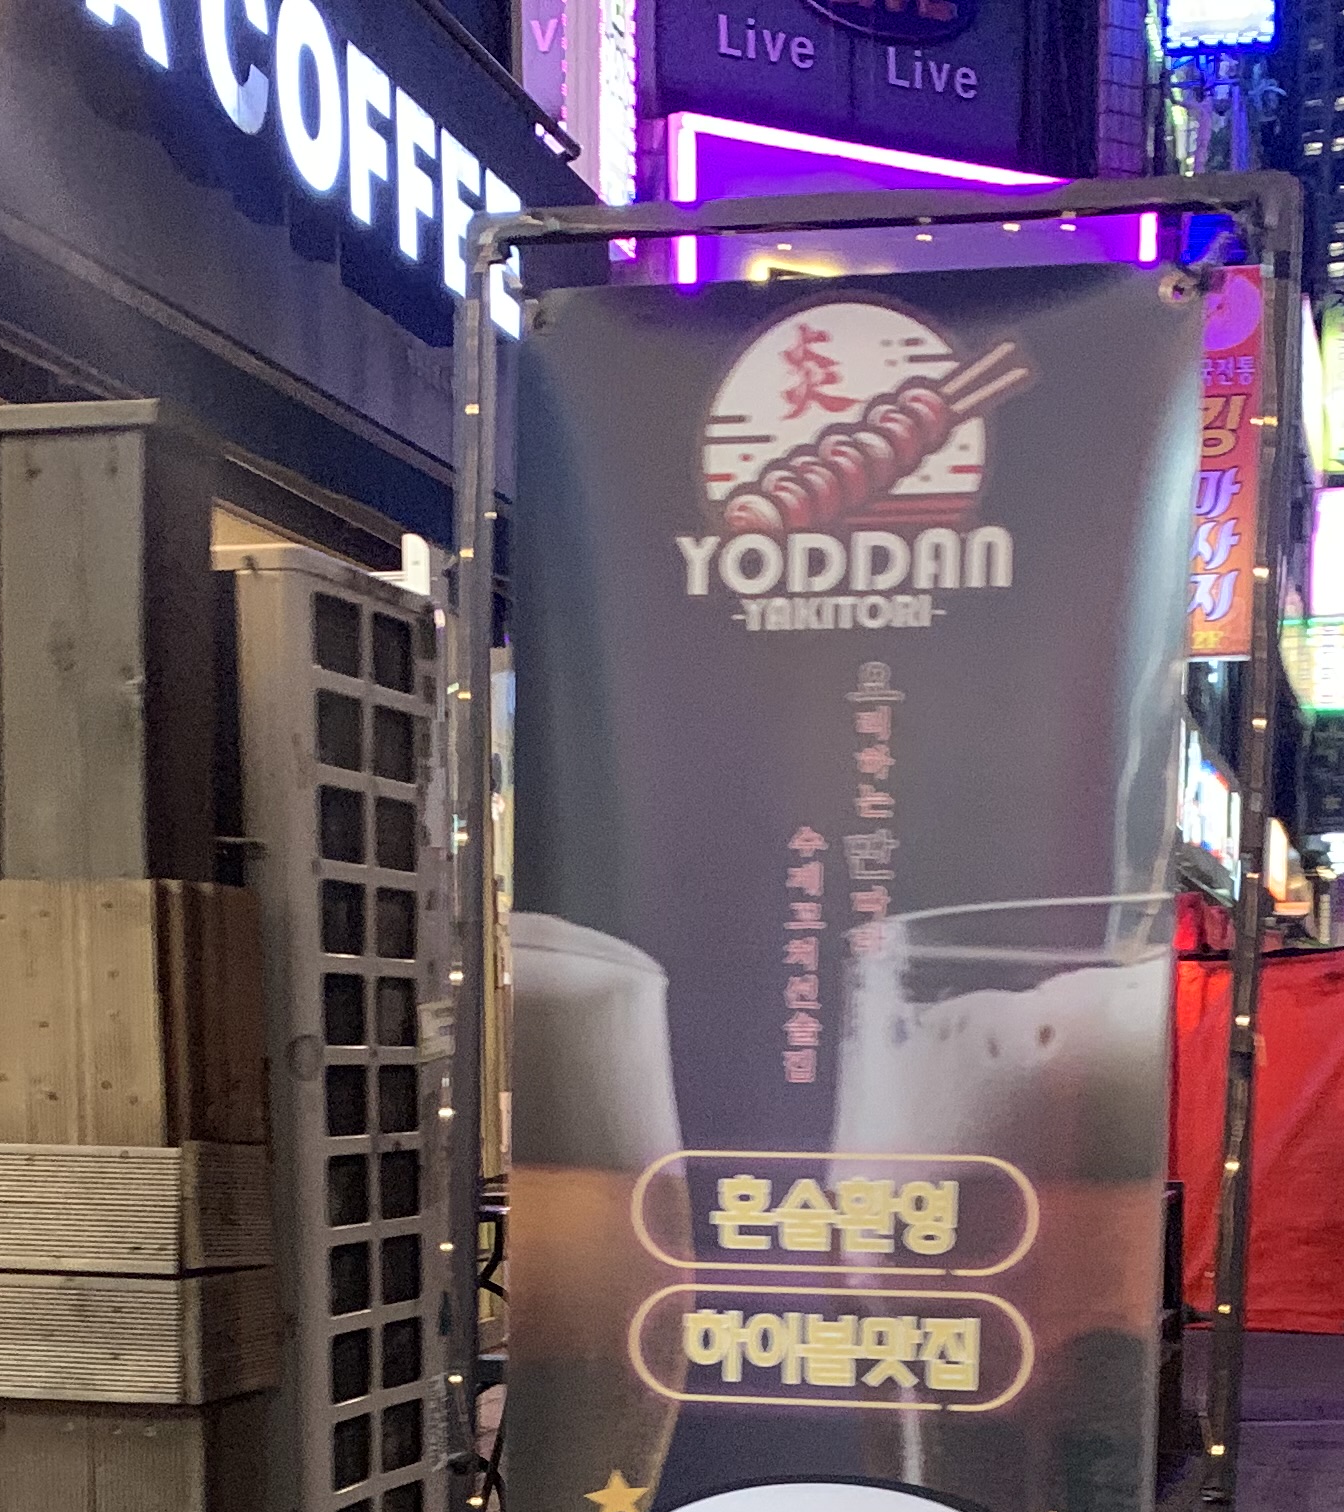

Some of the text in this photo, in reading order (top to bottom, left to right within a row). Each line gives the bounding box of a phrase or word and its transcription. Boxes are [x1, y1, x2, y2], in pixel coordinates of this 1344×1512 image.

[718, 14, 978, 98] Live Live
[200, 0, 522, 340] COFFEE
[676, 526, 1013, 595] YODDAN
[709, 1174, 959, 1255] 혼술환영
[683, 1308, 982, 1391] 하이볼맛집
